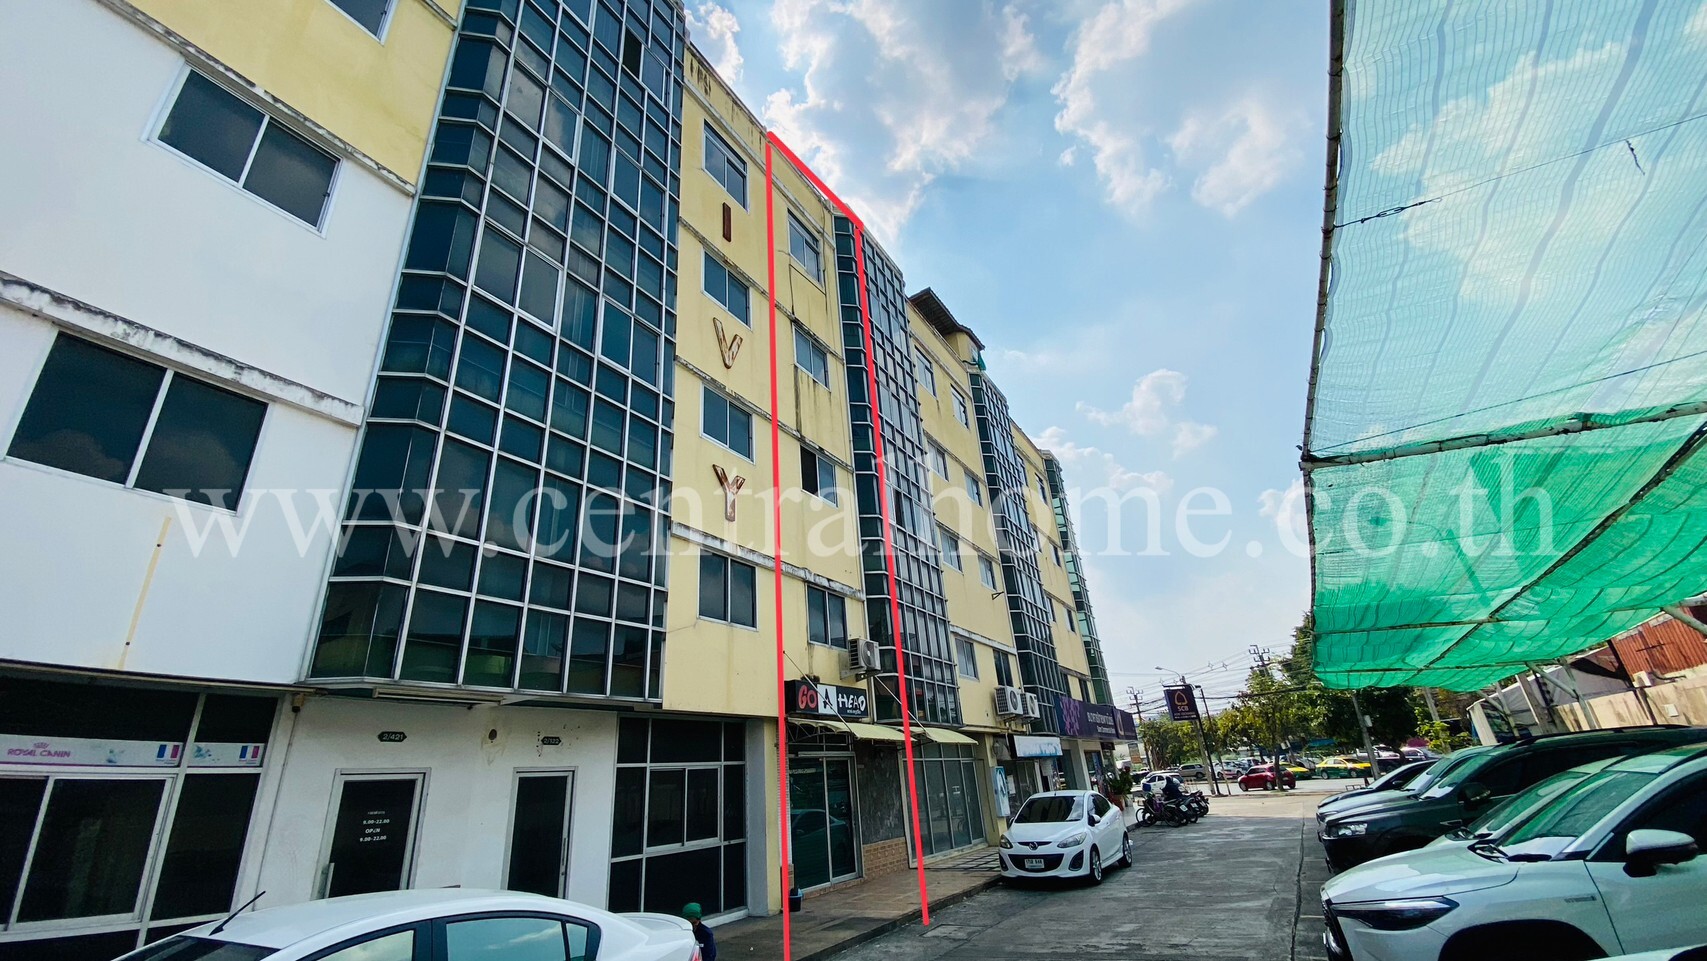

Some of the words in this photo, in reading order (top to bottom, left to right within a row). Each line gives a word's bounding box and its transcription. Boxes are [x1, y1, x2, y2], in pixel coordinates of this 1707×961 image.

[798, 685, 817, 709] GO
[823, 688, 833, 709] A
[838, 693, 866, 712] HEAD
[7, 748, 37, 757] ROYAL
[39, 749, 71, 758] CANIN
